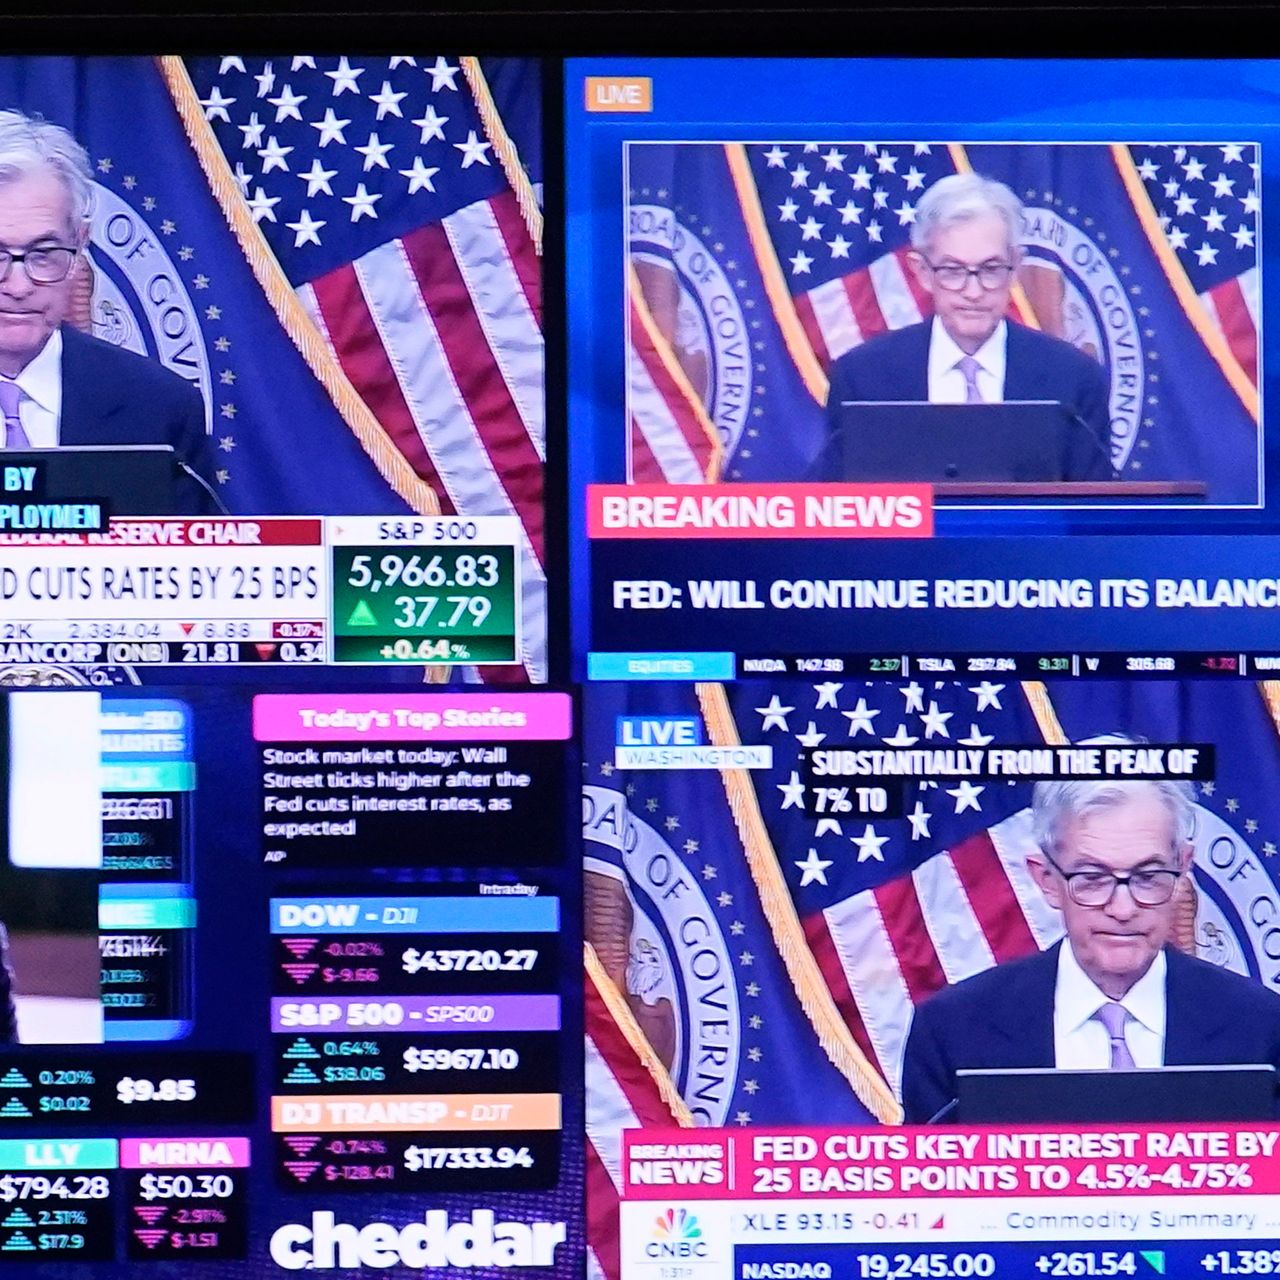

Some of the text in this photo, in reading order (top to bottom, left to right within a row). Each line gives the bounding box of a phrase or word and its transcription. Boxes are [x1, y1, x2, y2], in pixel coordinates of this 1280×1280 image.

[602, 497, 922, 527] BREAKING NEWS
[28, 568, 92, 599] CUTS
[105, 567, 179, 599] RATES
[191, 567, 222, 599] BY
[231, 567, 261, 599] 25
[273, 567, 318, 599] BPS
[348, 555, 498, 591] 5,966.83
[613, 581, 682, 609] FED:
[688, 581, 764, 609] WILL
[770, 581, 929, 609] CONTINUE
[935, 580, 1092, 608] REDUCING
[1100, 579, 1149, 607] ITS
[395, 597, 491, 628] 37.79
[3, 624, 31, 639] 2K
[623, 722, 694, 745] LIVE
[264, 747, 507, 767] Stock market today: Wall
[812, 748, 1197, 776] SUBSTANTIALLY FROM THE PEAK OF
[264, 771, 530, 791] Street ticks higher after the
[264, 796, 512, 813] Fed cuts interest rates, as
[264, 819, 356, 839] expected
[279, 905, 360, 927] DOW
[630, 1145, 722, 1159] BREAKING
[753, 1132, 1278, 1161] FED CUTS KEY INTEREST RATE BY
[630, 1162, 722, 1184] NEWS
[753, 1163, 1253, 1192] 25 BASIS POINTS TO 4.5%-4.75%
[140, 1173, 233, 1201] $50.30
[743, 1213, 788, 1231] XLE
[798, 1213, 853, 1231] 93.15
[863, 1213, 919, 1229] -0.41
[1008, 1210, 1138, 1231] Commodity
[1150, 1209, 1256, 1229] Summary
[270, 1209, 566, 1269] cheddar
[646, 1242, 707, 1258] CNBC
[743, 1264, 832, 1279] NASDAQ
[1035, 1252, 1137, 1276] +261.54
